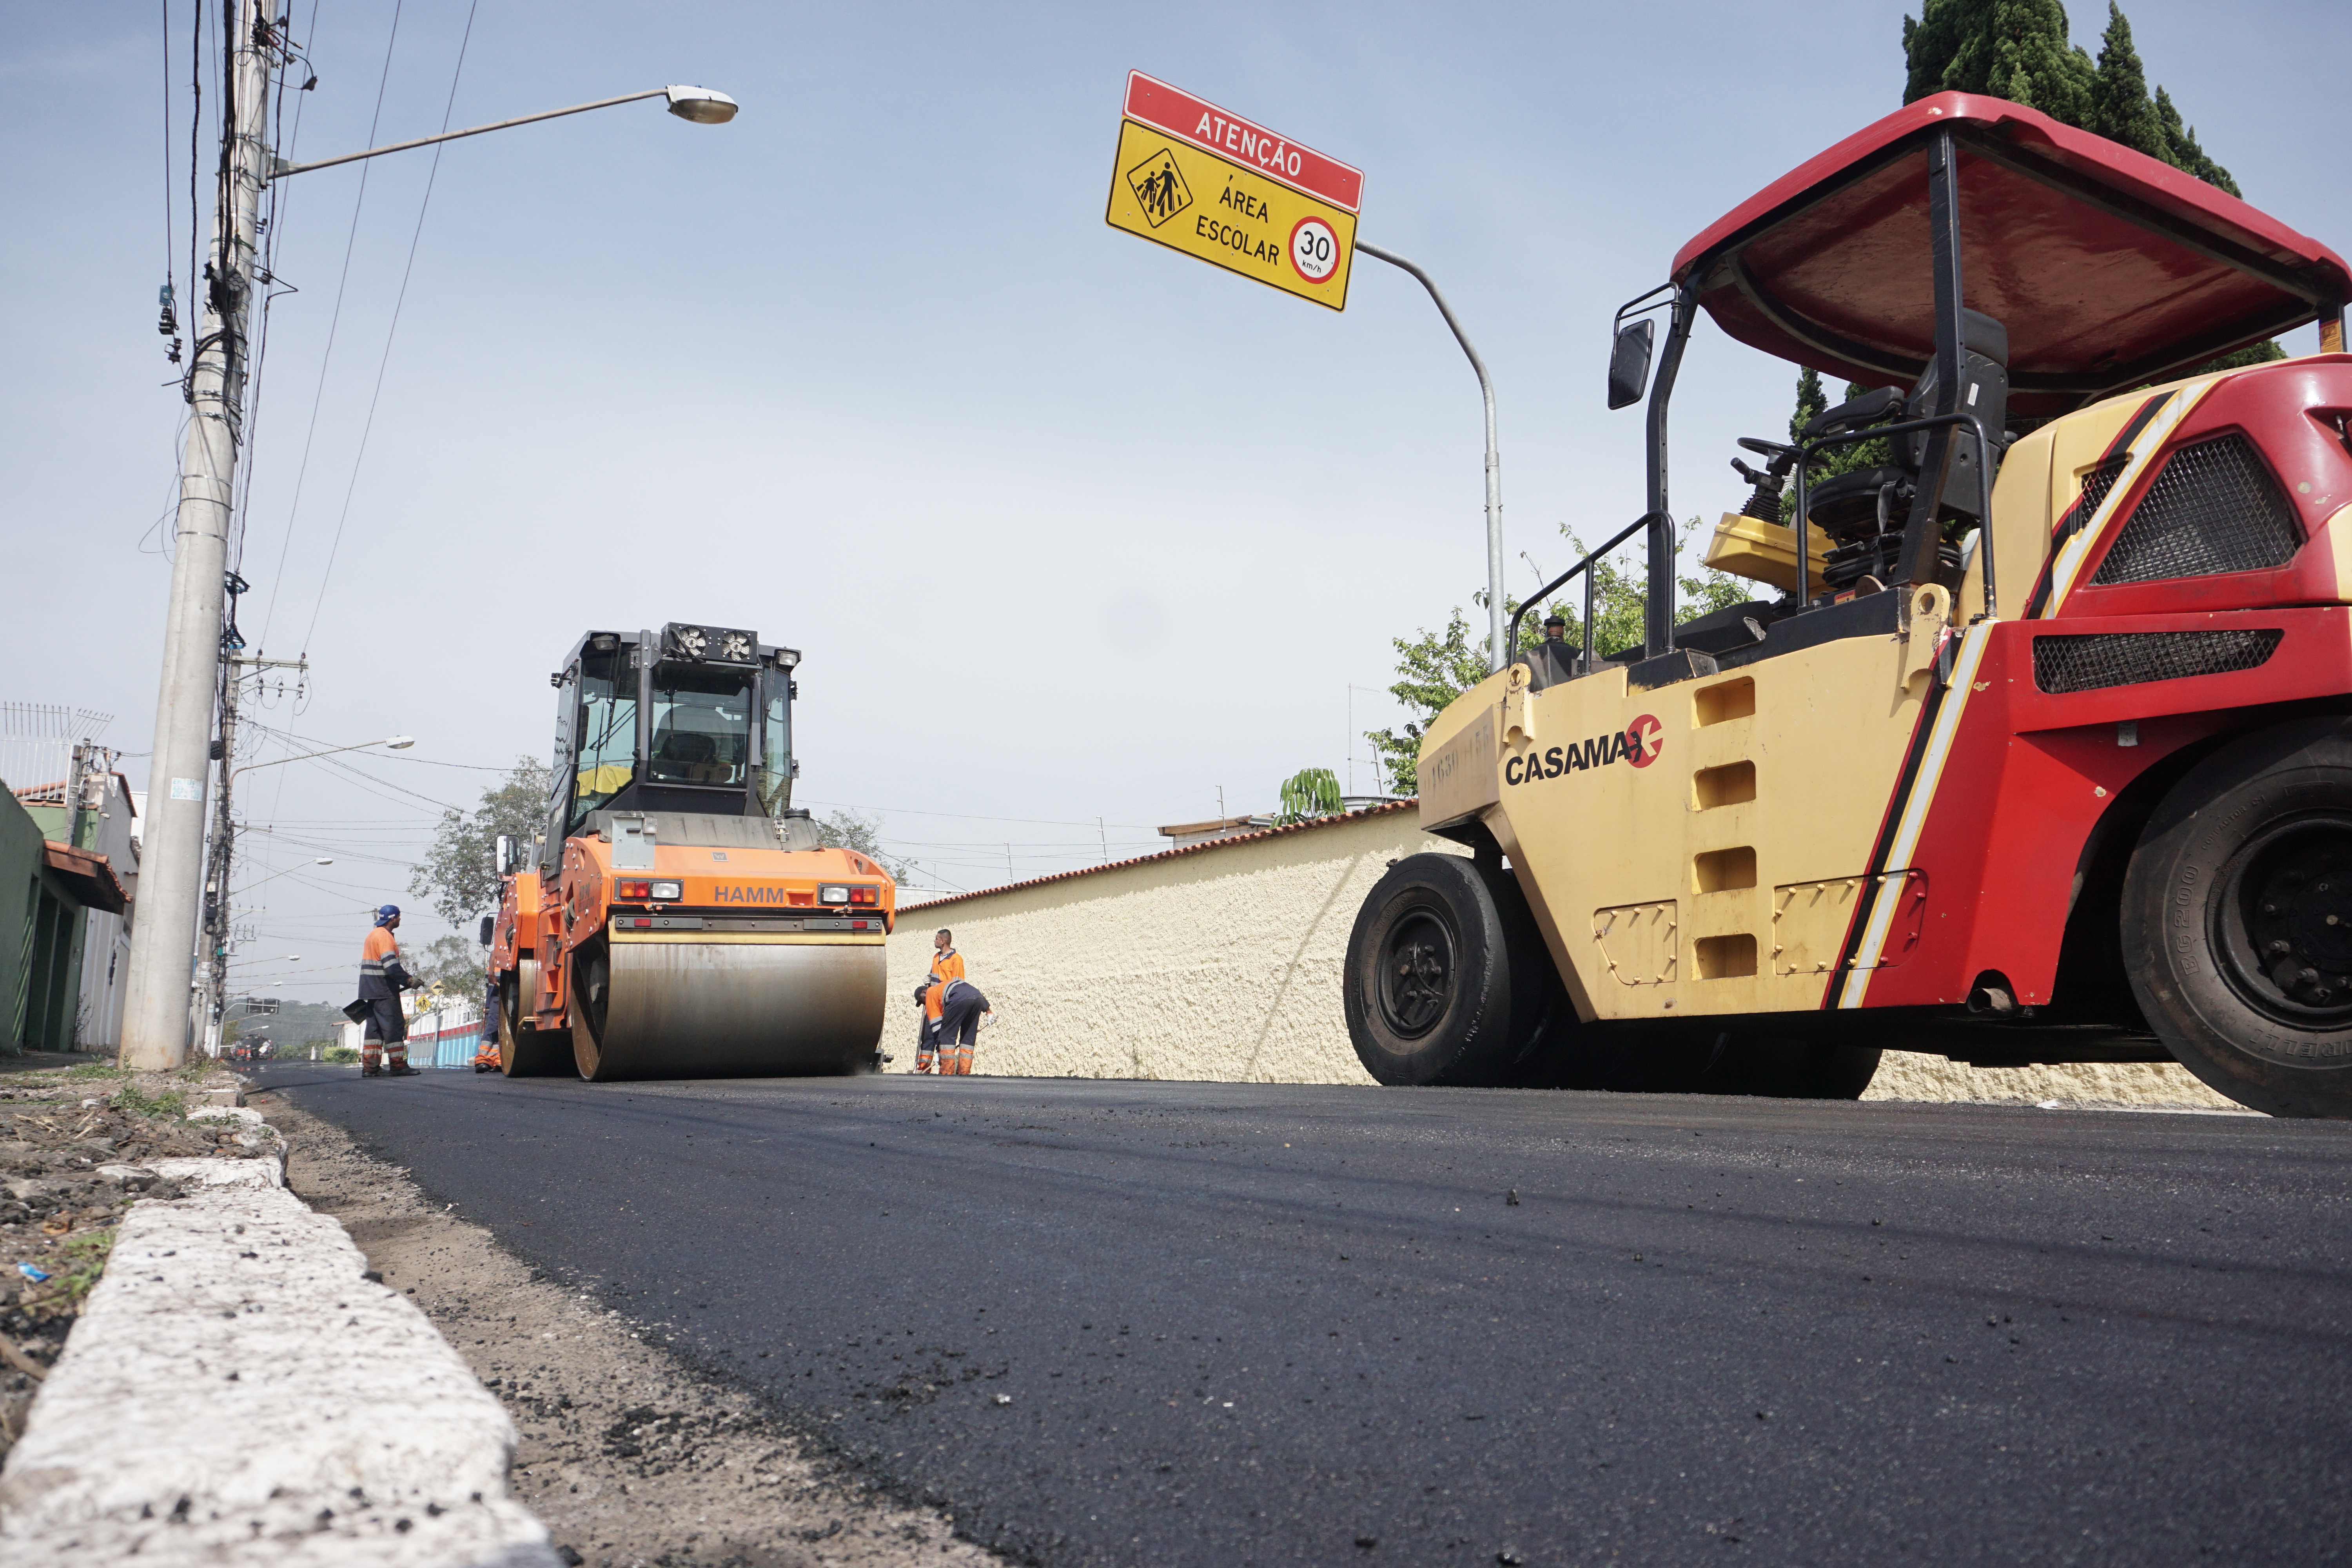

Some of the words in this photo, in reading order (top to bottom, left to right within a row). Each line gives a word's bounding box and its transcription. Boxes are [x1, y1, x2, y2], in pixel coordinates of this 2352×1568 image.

[1219, 174, 1268, 223] ÁREA
[1196, 214, 1279, 266] ESCOLAR
[1300, 230, 1330, 261] 30
[1302, 260, 1321, 273] km/h
[715, 886, 784, 903] HAMM
[2174, 865, 2199, 928] 200
[2176, 935, 2200, 976] BG
